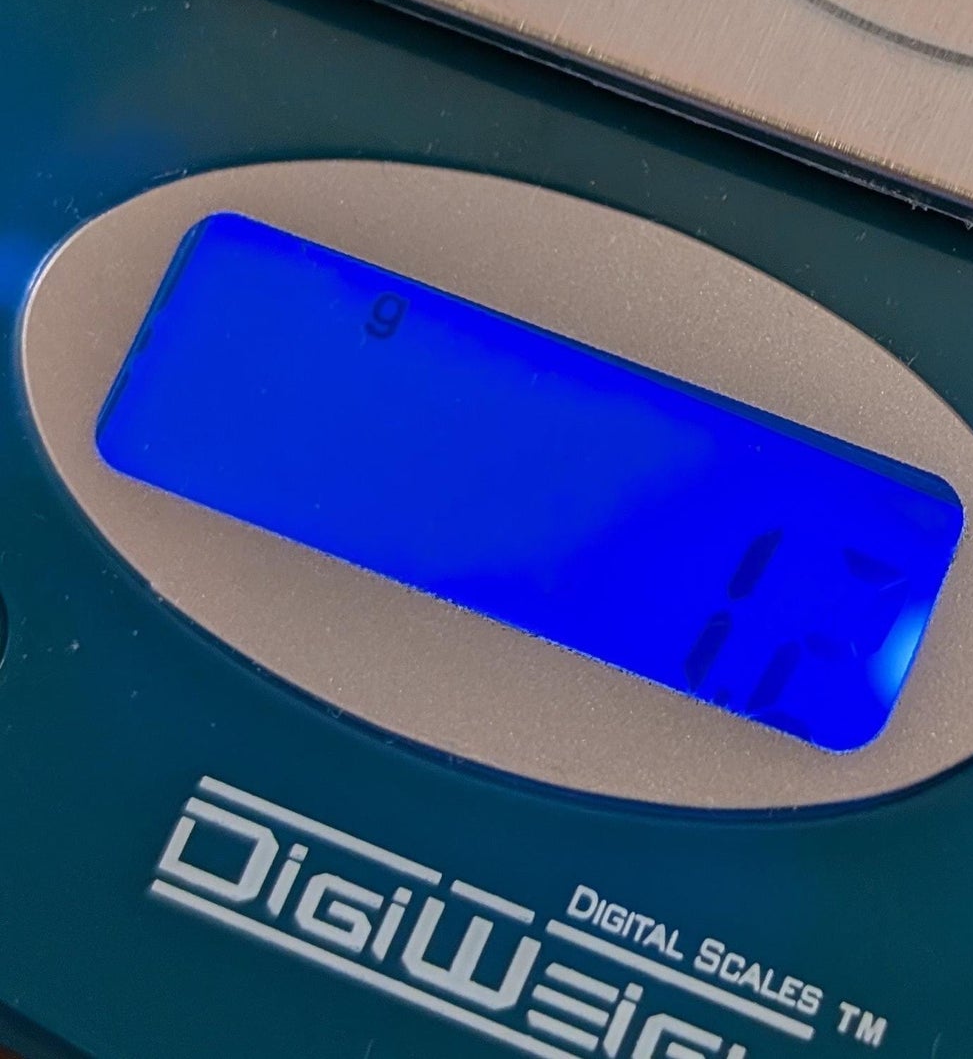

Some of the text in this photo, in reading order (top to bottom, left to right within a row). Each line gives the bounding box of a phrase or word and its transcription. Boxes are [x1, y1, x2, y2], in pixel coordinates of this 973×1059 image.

[364, 291, 409, 339] g
[566, 883, 888, 1048] DIGITAL SCALES TM
